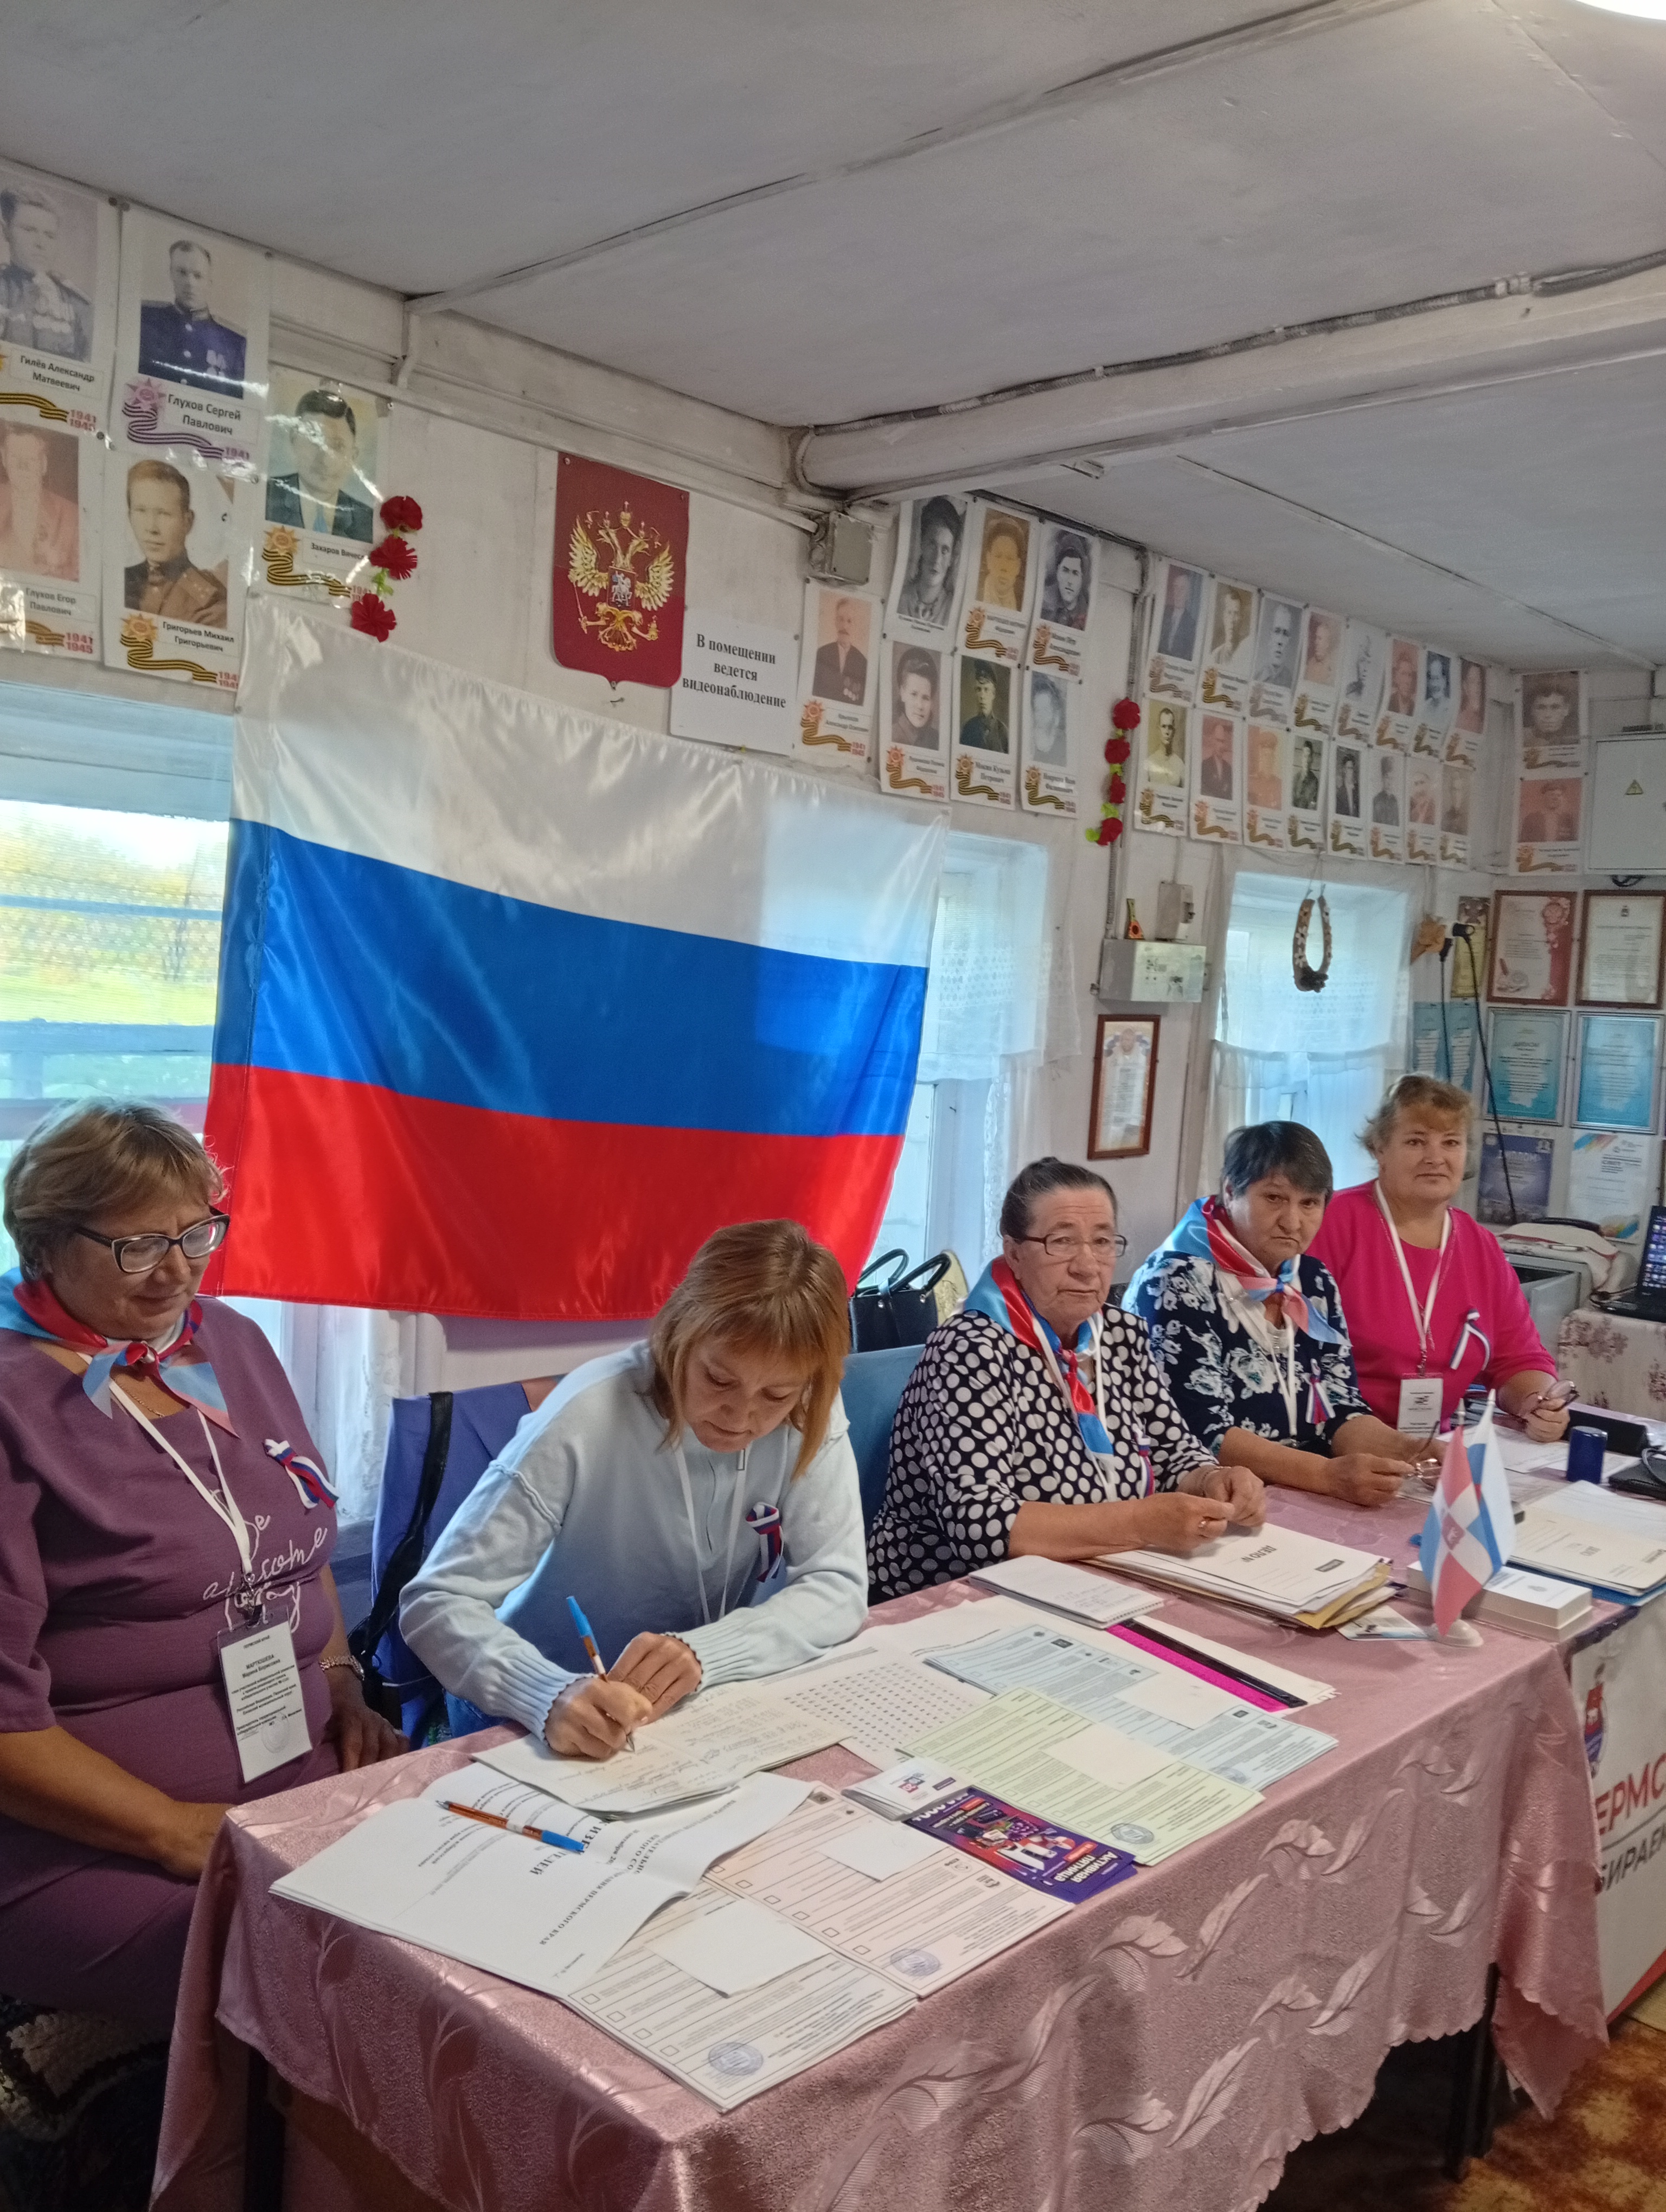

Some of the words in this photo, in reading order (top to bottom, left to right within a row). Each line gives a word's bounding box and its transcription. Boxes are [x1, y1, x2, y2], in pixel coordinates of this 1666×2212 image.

[20, 356, 46, 369] Гилёв
[48, 363, 94, 383] Александр
[33, 372, 80, 391] Матвеевич
[168, 394, 203, 411] Глухов
[206, 404, 241, 421] Сергей
[183, 415, 233, 435] Павлович
[311, 543, 339, 555] Захаров
[26, 588, 55, 601] Глухов
[57, 594, 76, 605] Егор
[30, 602, 72, 616] Павлович
[163, 622, 202, 636] Григорьев
[204, 631, 234, 643] Михаил
[696, 633, 704, 647] В
[175, 636, 223, 652] Григорьевич
[714, 663, 758, 681] ведется
[683, 678, 786, 708] видеонаблюдение
[1250, 1545, 1277, 1559] ДЕЛО
[1595, 1752, 1666, 1836] ЕРМС
[1052, 1854, 1096, 1882] пятница
[1069, 1851, 1118, 1883] Активная
[558, 1890, 598, 1929] ПЕРМСКОГО
[539, 1928, 559, 1946] КРАЯ
